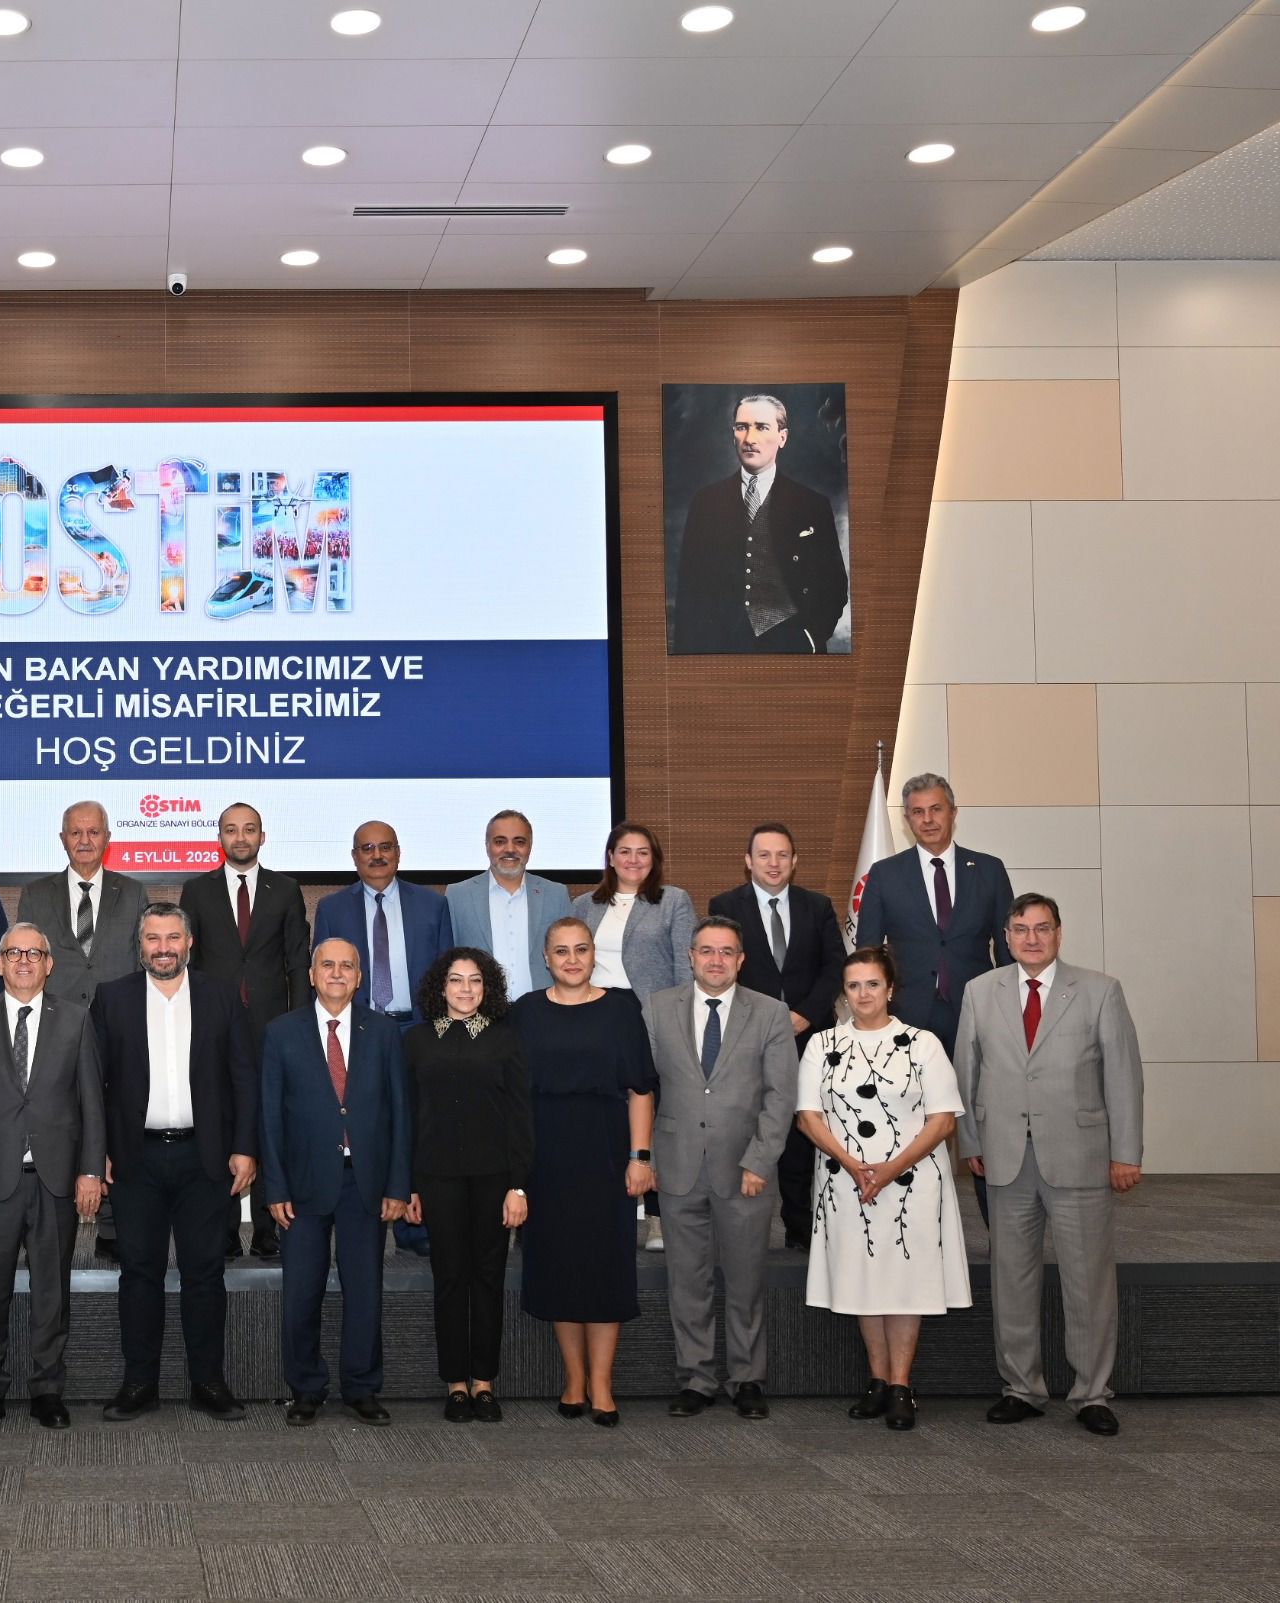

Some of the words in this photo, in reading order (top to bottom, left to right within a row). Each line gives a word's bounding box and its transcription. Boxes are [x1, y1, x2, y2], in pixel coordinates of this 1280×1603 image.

[66, 484, 79, 492] 5G
[25, 656, 139, 681] BAKAN
[152, 655, 372, 681] YARDIMCIMIZ
[380, 655, 424, 680] VE
[115, 686, 381, 718] MİSAFİRLERİMİZ
[36, 736, 116, 772] HOŞ
[129, 731, 306, 765] GELDİNİZ
[191, 819, 220, 827] BÖLGE
[122, 852, 131, 863] 4
[134, 849, 181, 863] EYLÜL
